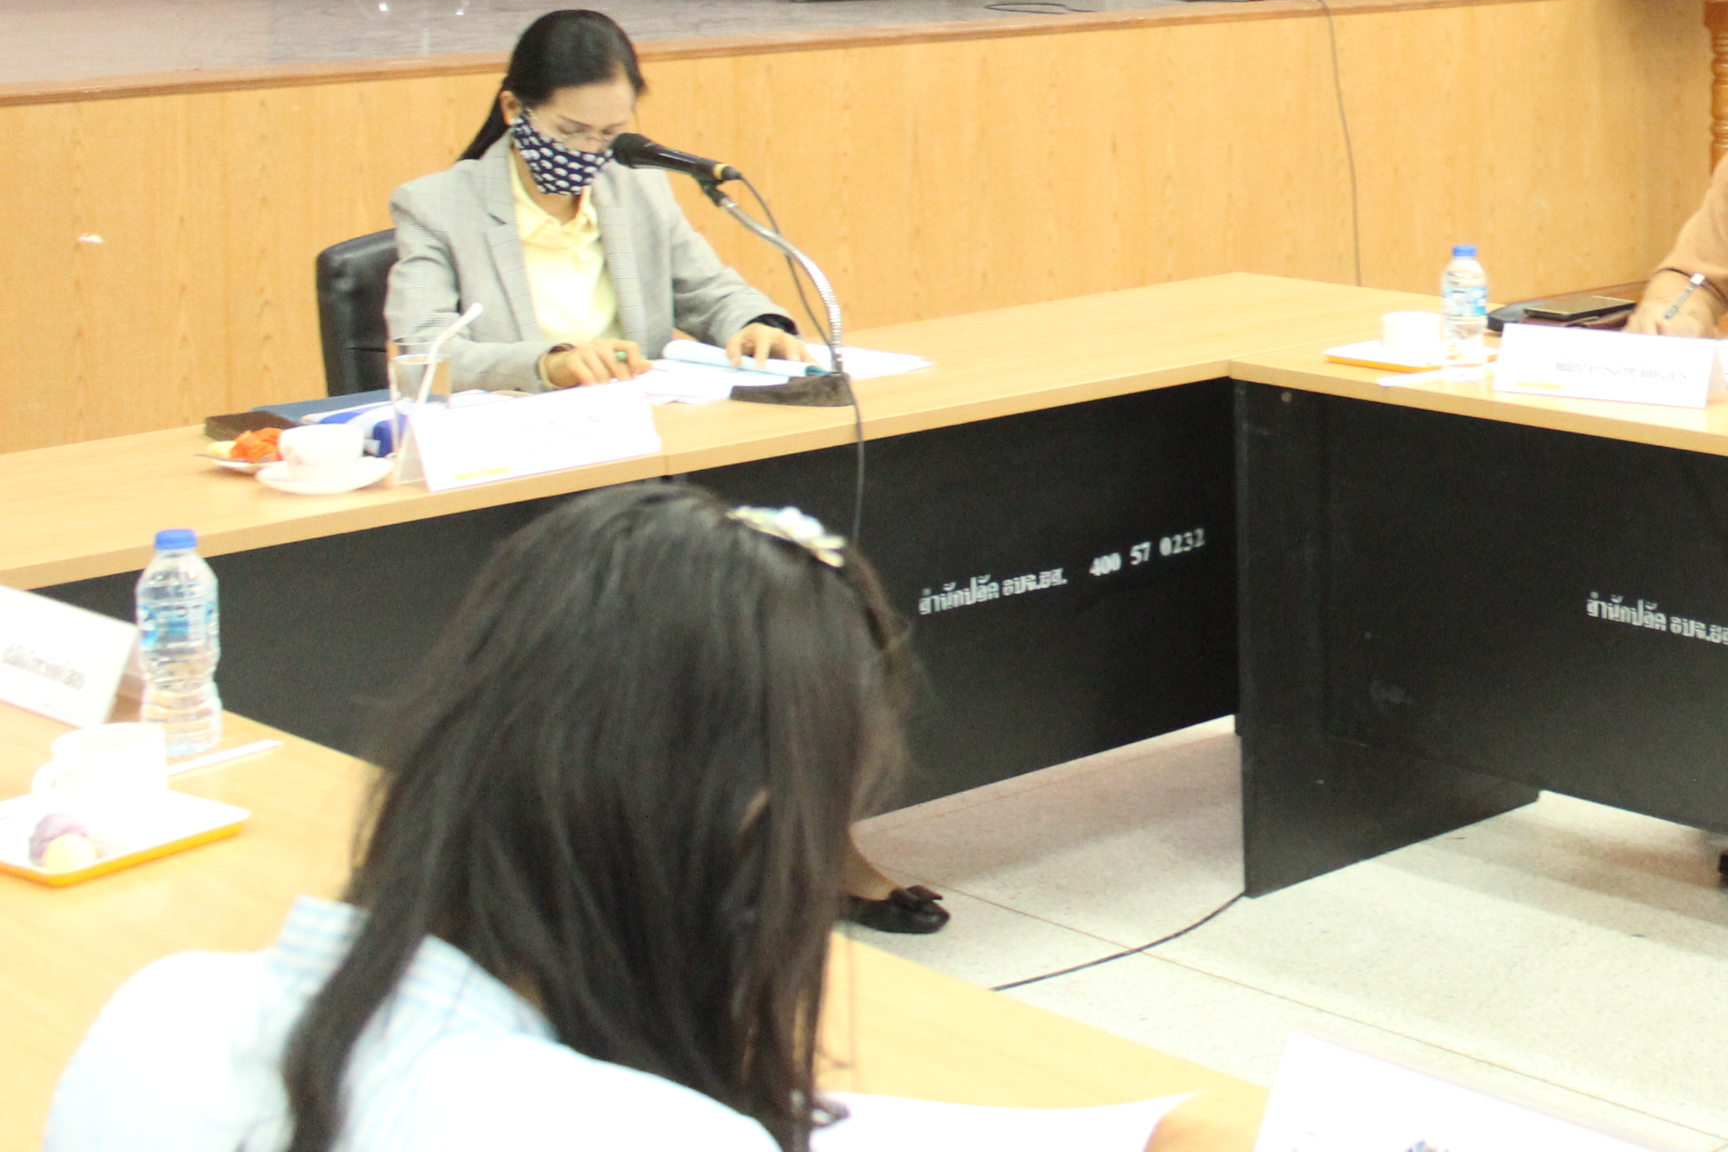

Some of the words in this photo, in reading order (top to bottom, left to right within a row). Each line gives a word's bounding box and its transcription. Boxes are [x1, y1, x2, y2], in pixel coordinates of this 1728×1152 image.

[1088, 551, 1122, 577] 400
[1130, 541, 1152, 566] 57
[1158, 528, 1204, 556] 0232
